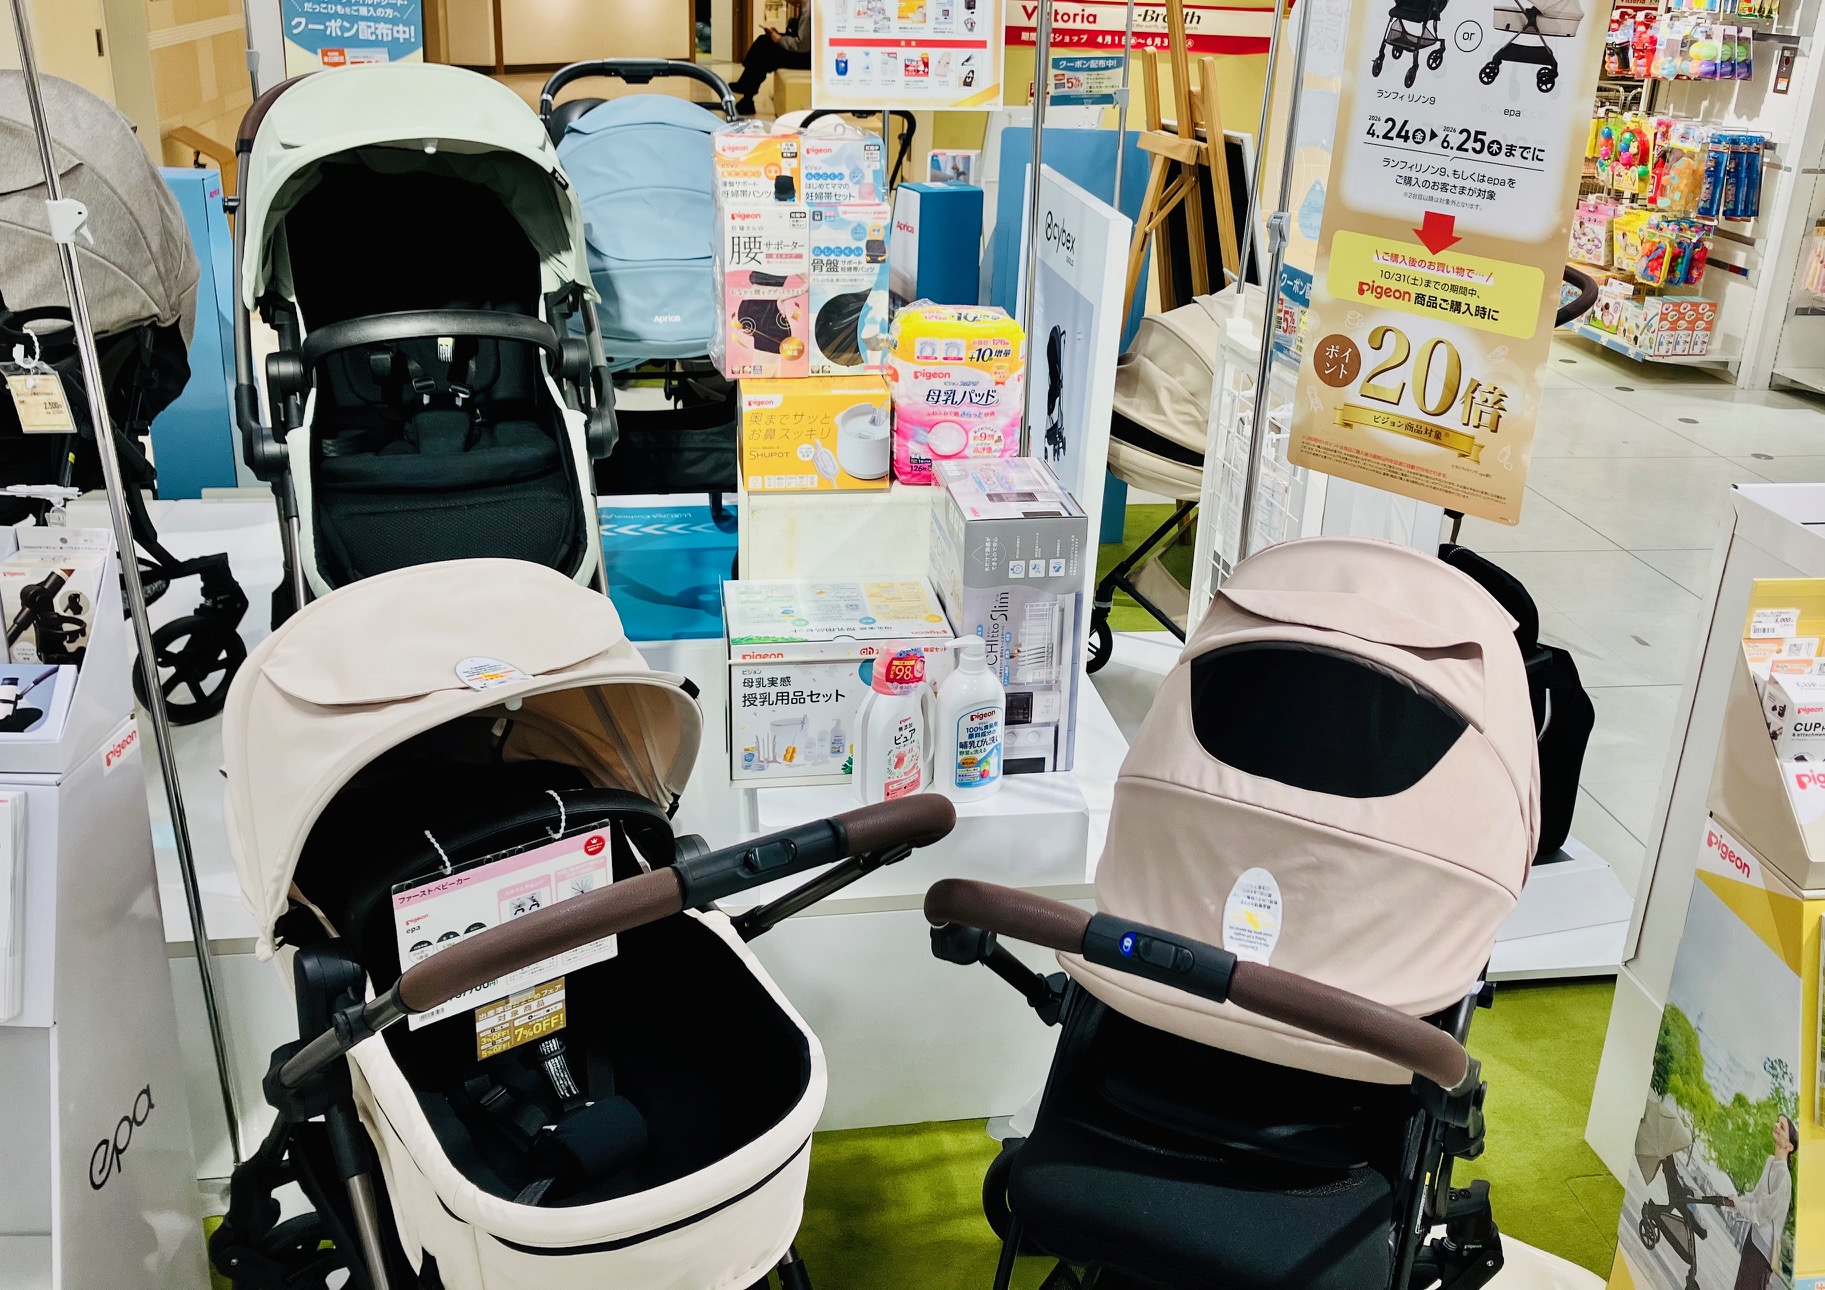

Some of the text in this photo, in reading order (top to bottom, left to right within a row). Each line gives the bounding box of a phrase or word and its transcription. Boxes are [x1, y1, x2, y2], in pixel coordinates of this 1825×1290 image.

[1022, 5, 1097, 24] Vtoria
[290, 17, 415, 43] クーポン配布中!
[1462, 31, 1475, 41] or
[1058, 60, 1117, 69] クーポン配布中!
[1503, 108, 1521, 118] epa
[806, 147, 832, 155] pigeon
[1382, 157, 1516, 189] ランフィリノン9、もしくはepaを
[721, 190, 772, 198] 妊婦帯パンツ
[1395, 174, 1496, 201] ご購入のお客さまが対象
[806, 192, 856, 201] 妊婦帯セット
[731, 212, 761, 220] pigeon
[896, 220, 914, 234] Aprica
[1053, 218, 1076, 256] cybex
[729, 236, 805, 266] 腰 サポーター
[811, 259, 839, 273] 骨盤
[1380, 269, 1481, 299] 10/31(土)までの期間中、
[1414, 293, 1500, 322] 商品ご購入時に
[653, 314, 681, 323] Aprica
[914, 370, 950, 380] pigeon
[926, 389, 999, 406] 母乳パッド
[750, 412, 831, 426] 奥までサッと
[749, 428, 831, 441] お鼻スッキリ
[750, 450, 790, 460] SHUPOT
[990, 592, 1009, 622] Slim
[742, 676, 792, 688] 母乳実感
[742, 689, 846, 708] 授乳用品セット
[1794, 722, 1821, 732] CUP
[894, 728, 916, 746] ピュア
[106, 729, 137, 767] pigeon
[1707, 829, 1750, 878] pigeon
[398, 877, 470, 904] ファーストベビーカー
[406, 913, 428, 926] pigeon
[406, 924, 420, 934] epa
[514, 1013, 564, 1042] 7%OFF!
[89, 1084, 154, 1190] epa
